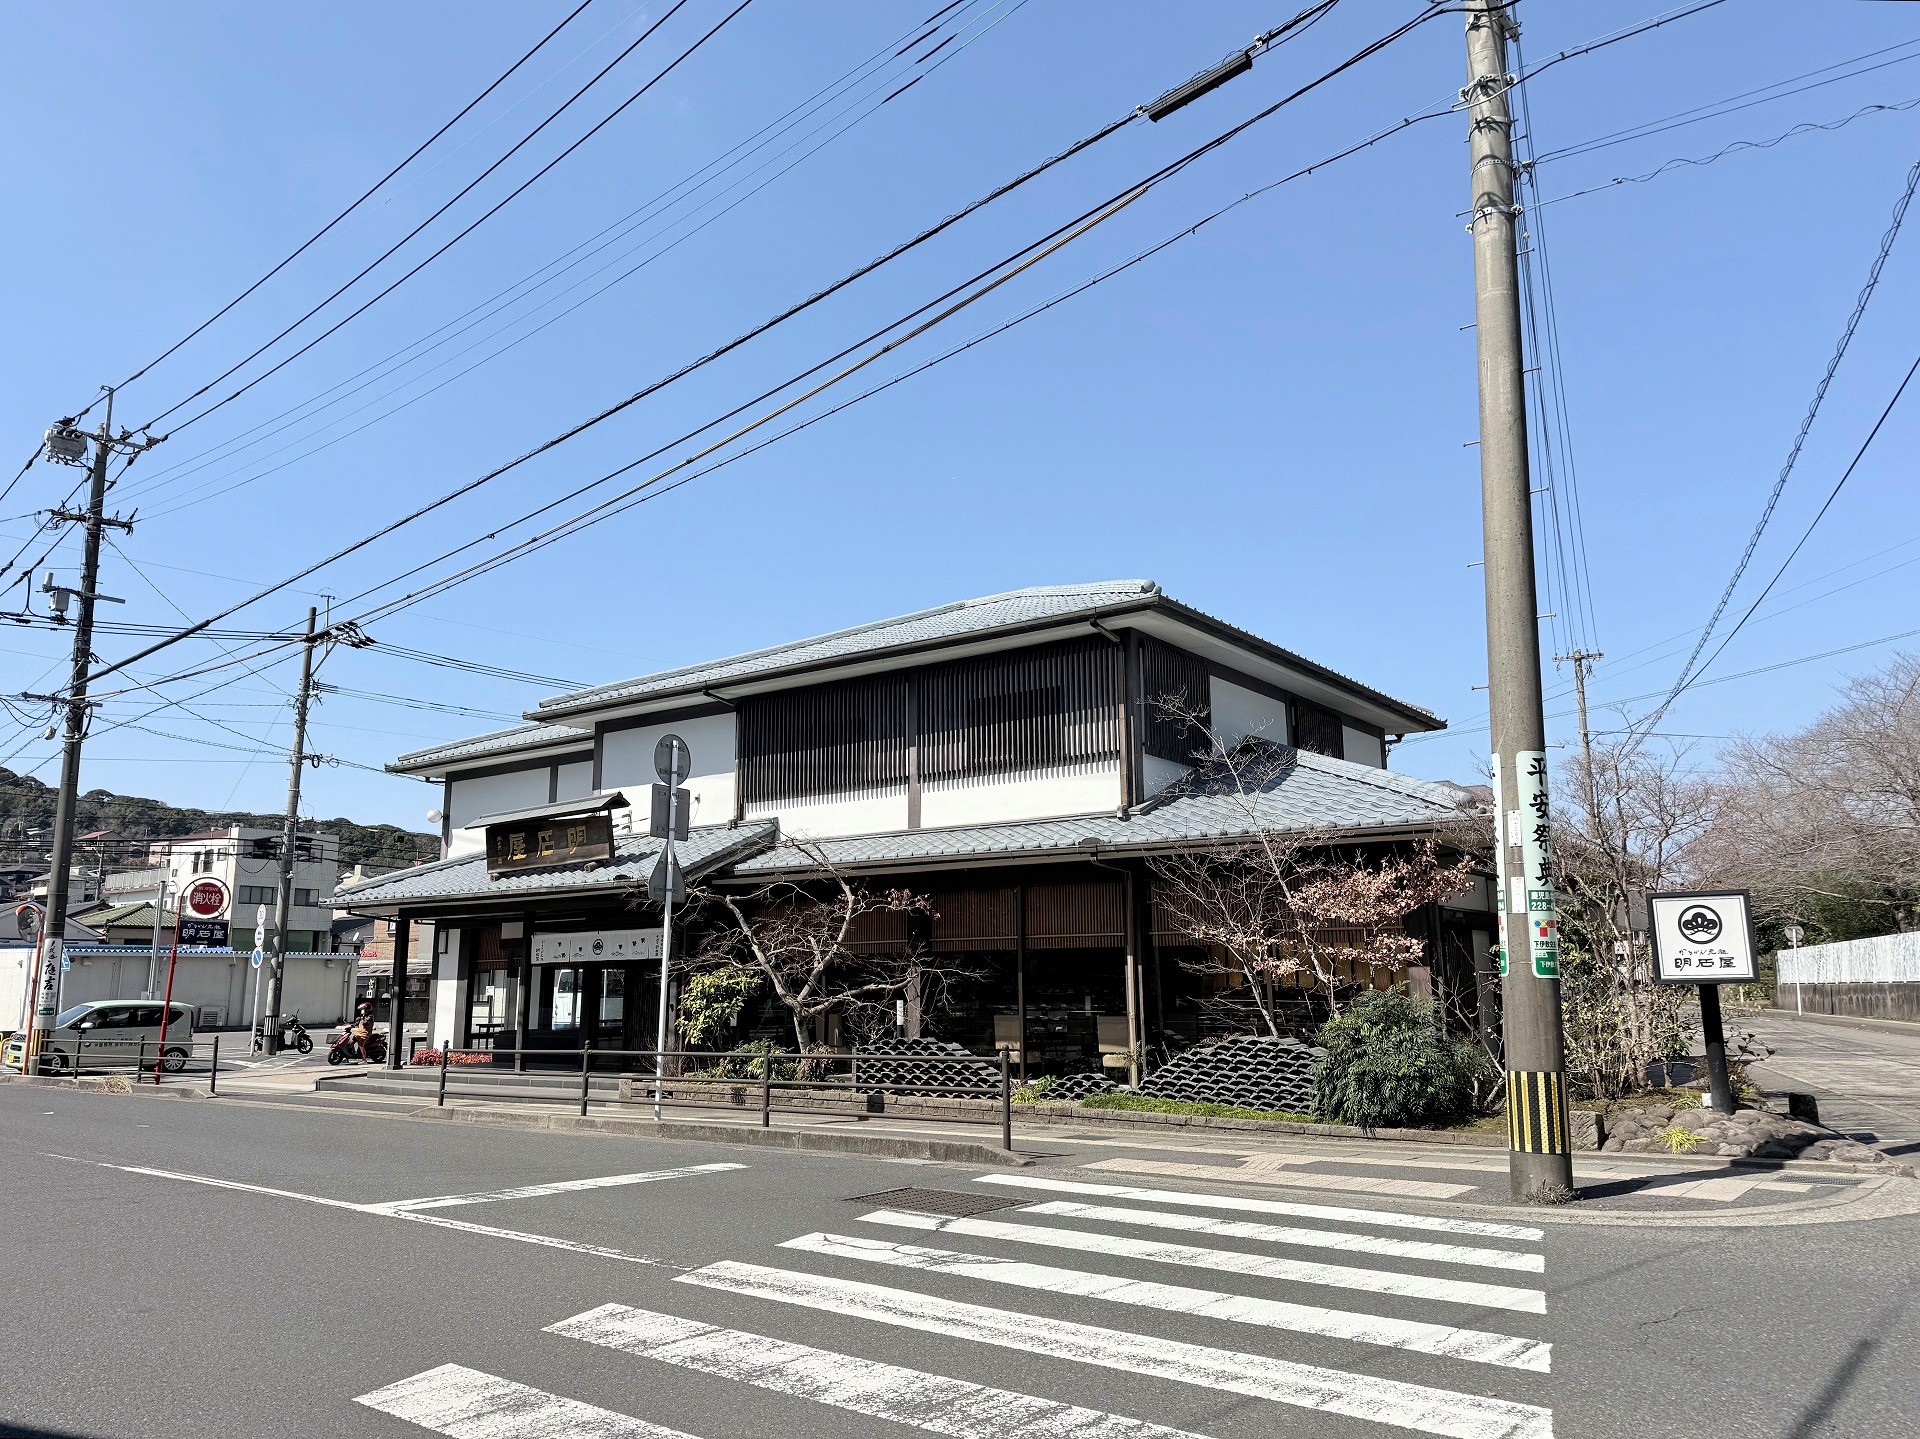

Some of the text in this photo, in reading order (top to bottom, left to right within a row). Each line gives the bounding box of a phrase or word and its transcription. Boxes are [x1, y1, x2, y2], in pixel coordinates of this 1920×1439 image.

[1527, 757, 1554, 887] 平安祭典
[192, 892, 222, 906] 消火栓
[182, 928, 225, 940] 明石屋
[1674, 956, 1737, 972] 明石屋
